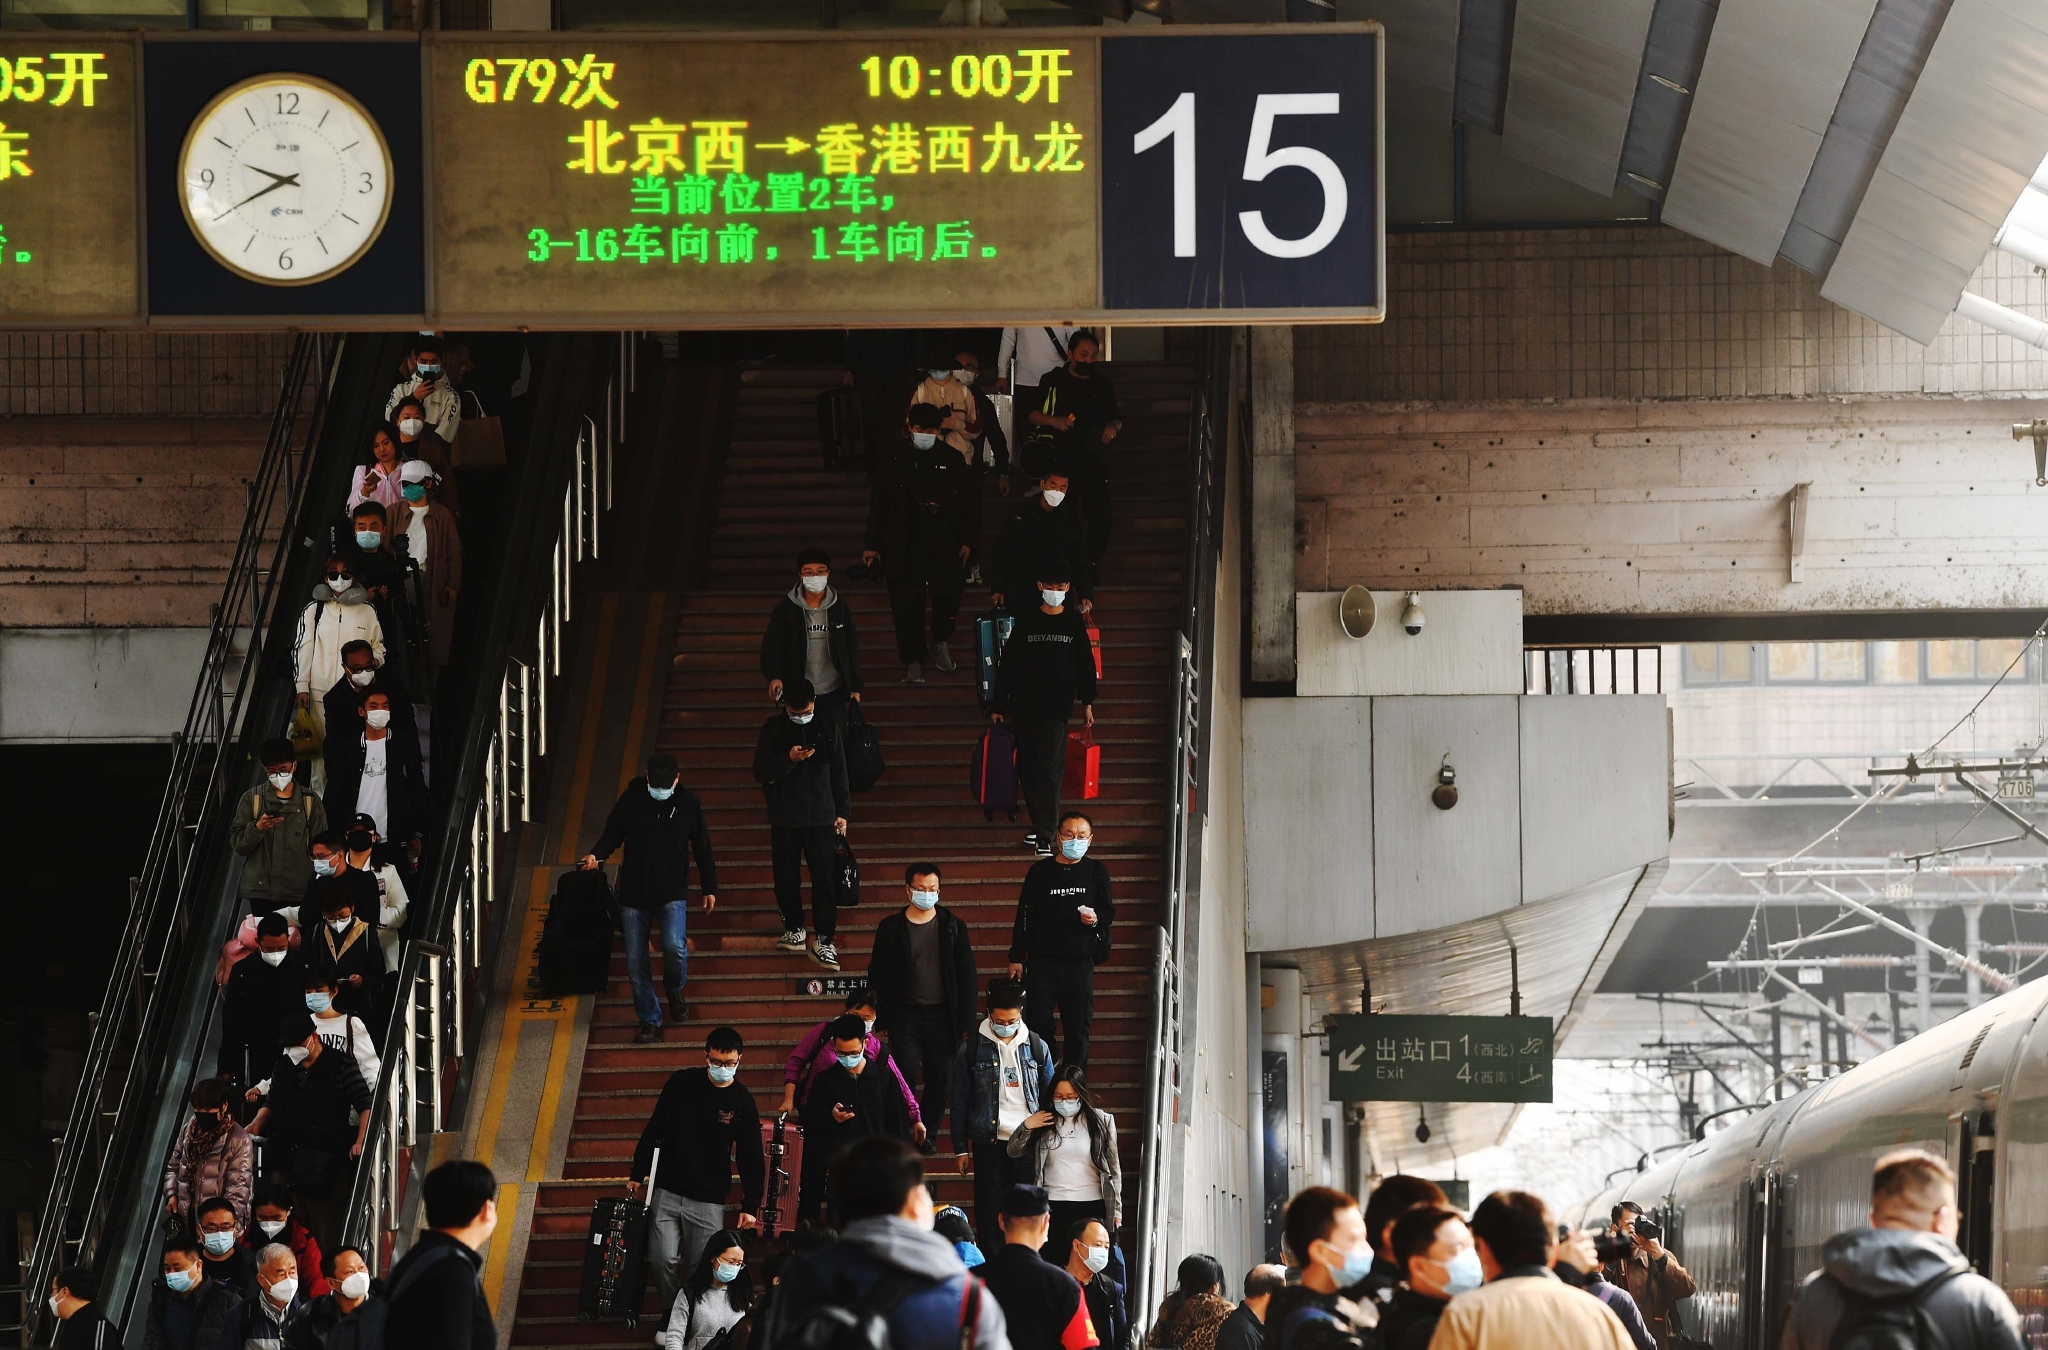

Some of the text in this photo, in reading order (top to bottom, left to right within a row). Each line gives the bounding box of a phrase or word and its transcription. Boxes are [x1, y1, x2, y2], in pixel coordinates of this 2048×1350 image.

[465, 53, 620, 110] G79次
[860, 49, 1073, 104] 10:00开
[275, 92, 301, 116] 12
[201, 168, 215, 191] 9
[358, 172, 374, 195] 3
[1134, 92, 1348, 258] 15
[278, 247, 294, 271] 6
[2002, 781, 2032, 796] 1706
[826, 979, 868, 989] 禁止上行
[1376, 1037, 1451, 1062] 出站口
[1376, 1066, 1405, 1080] Exit
